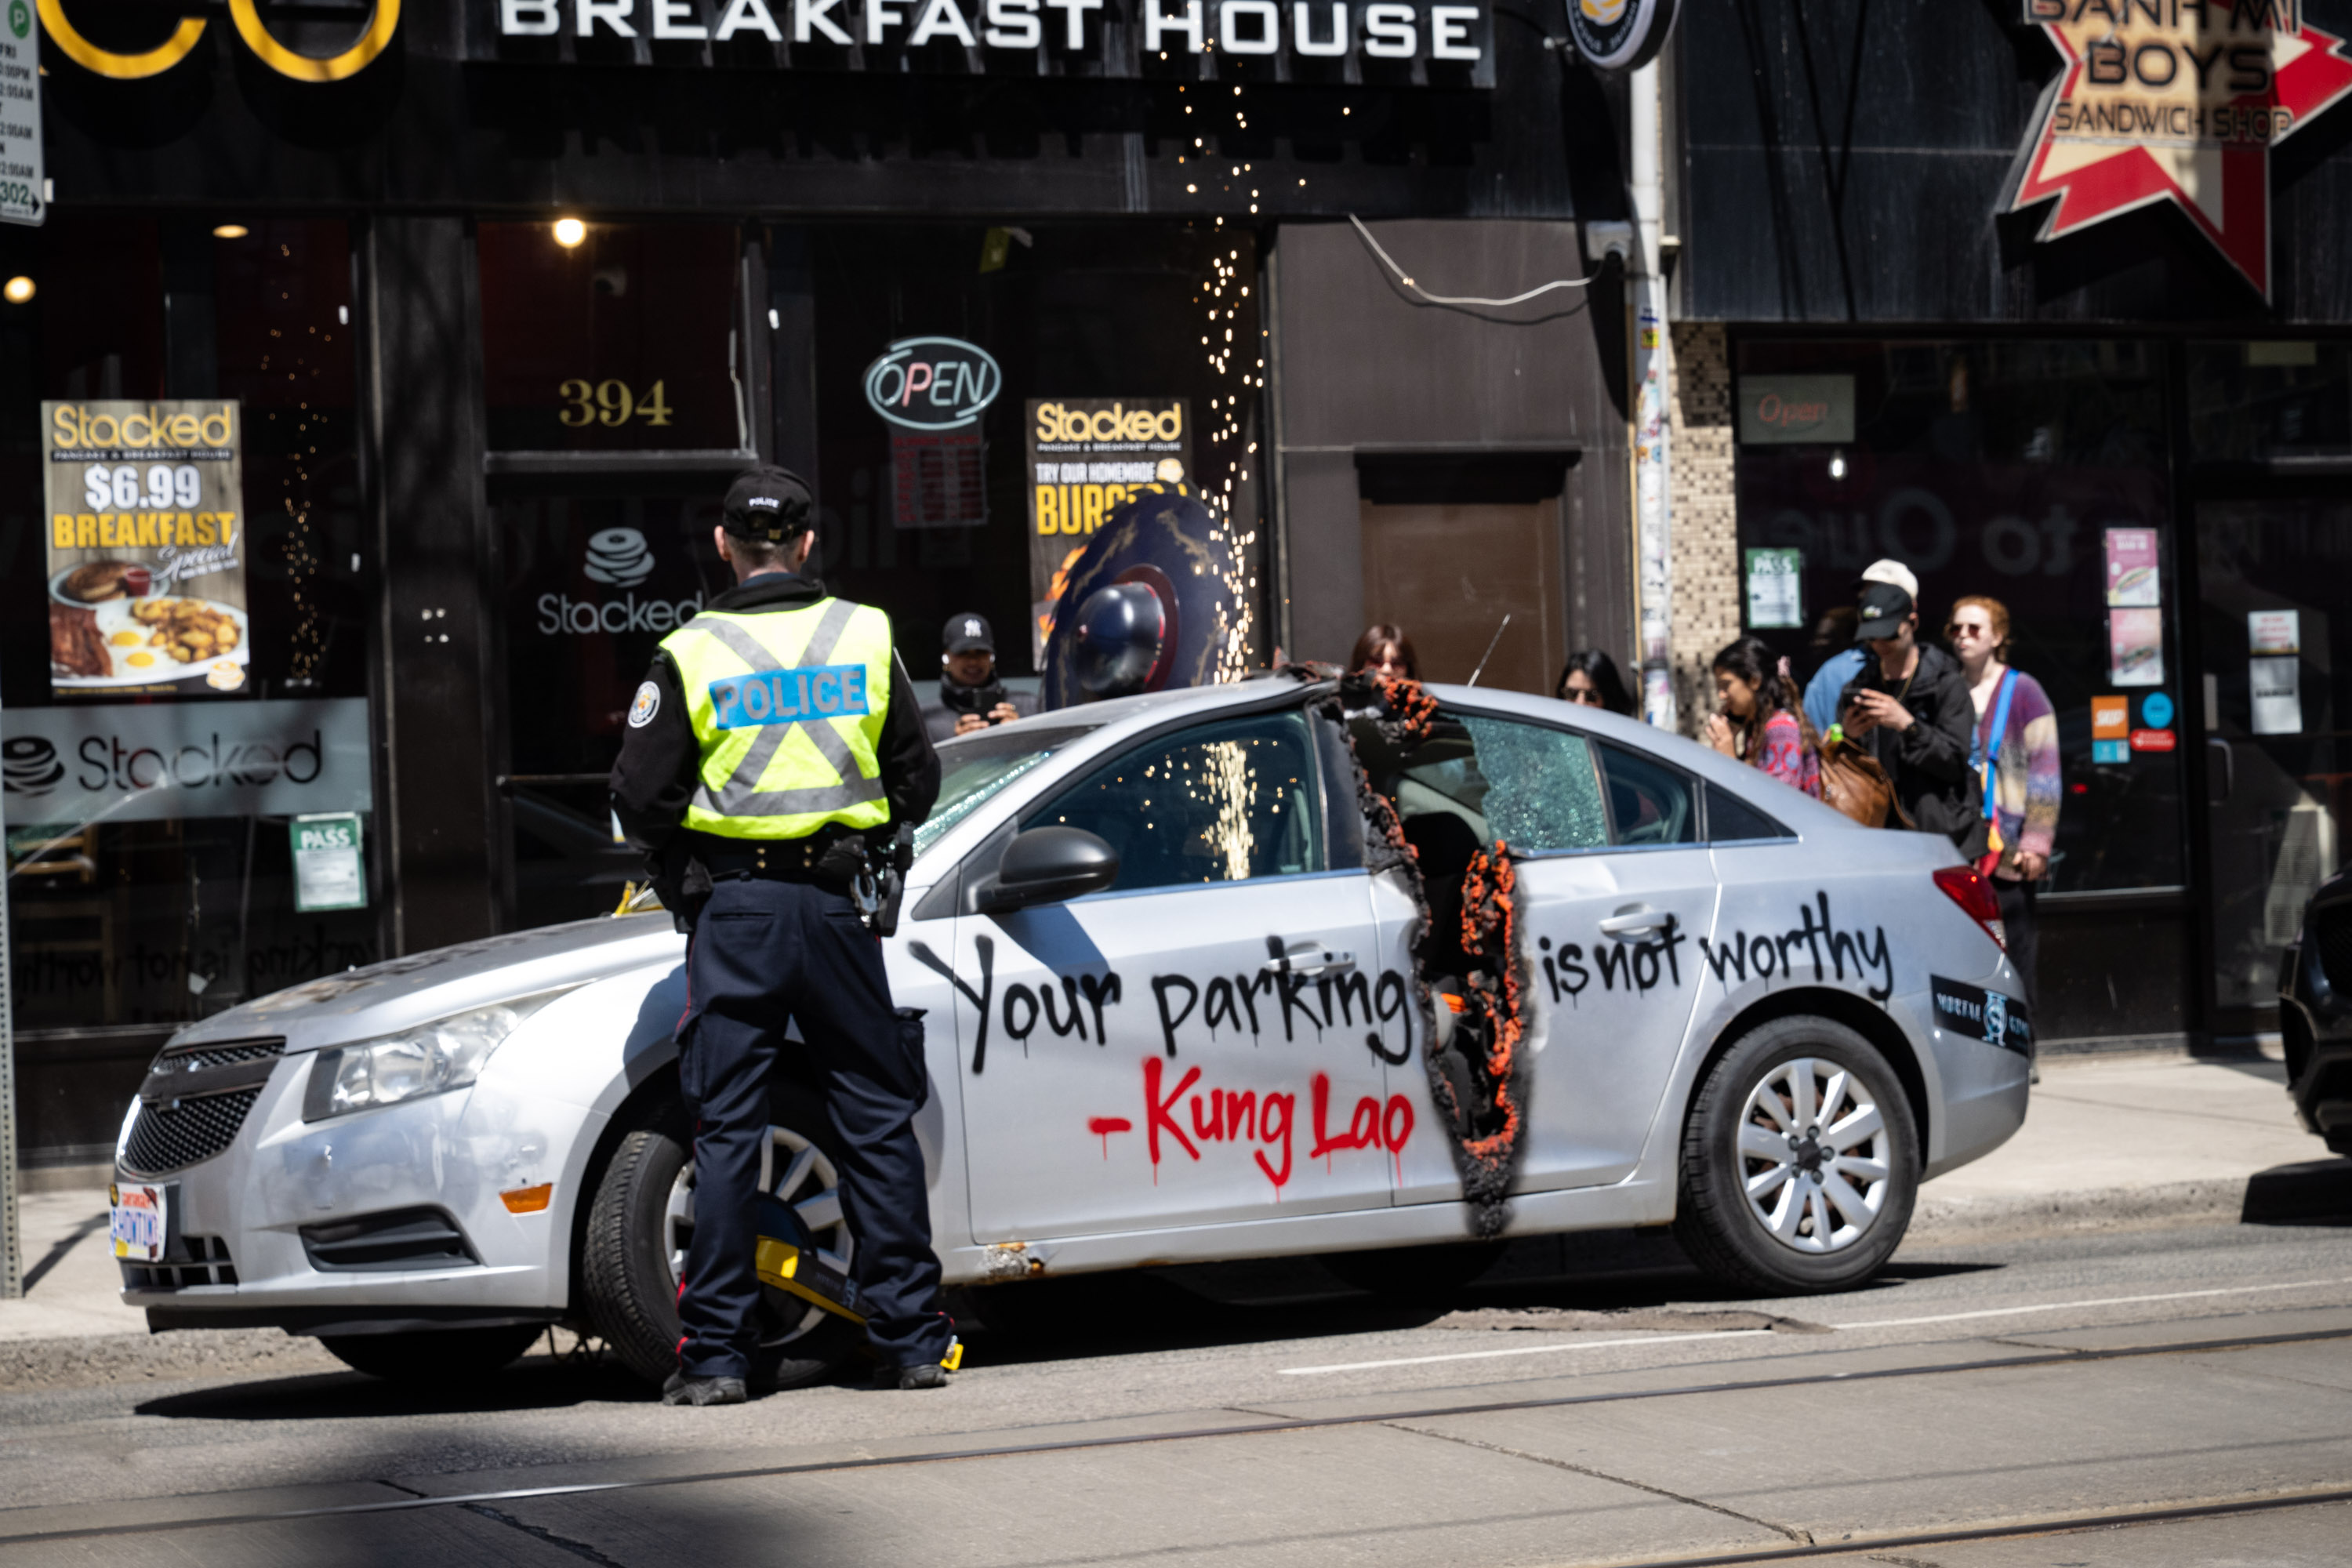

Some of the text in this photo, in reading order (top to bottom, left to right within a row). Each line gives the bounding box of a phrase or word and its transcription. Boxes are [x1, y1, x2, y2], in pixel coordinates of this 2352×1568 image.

[502, 0, 1481, 60] BREAKFAST HOUSE
[2087, 40, 2271, 93] BOYS
[2054, 101, 2293, 142] SANDWICH SHOP
[0, 180, 29, 205] 302
[559, 379, 673, 427] 394
[873, 361, 988, 407] OPEN
[53, 404, 232, 448] Stacked
[1036, 401, 1182, 442] Stacked
[1758, 393, 1828, 427] Open
[84, 463, 201, 512] $6.99
[1035, 461, 1156, 484] TRY OUR HOMEMADE
[53, 512, 236, 548] BREAKFAST
[1753, 556, 1793, 574] PASS
[538, 590, 703, 636] Stacked
[713, 670, 866, 724] POLICE
[79, 729, 322, 791] Stacked
[300, 827, 351, 848] PASS
[907, 890, 1894, 1075] Your parking is not worthy
[1309, 1070, 1416, 1162] Lao
